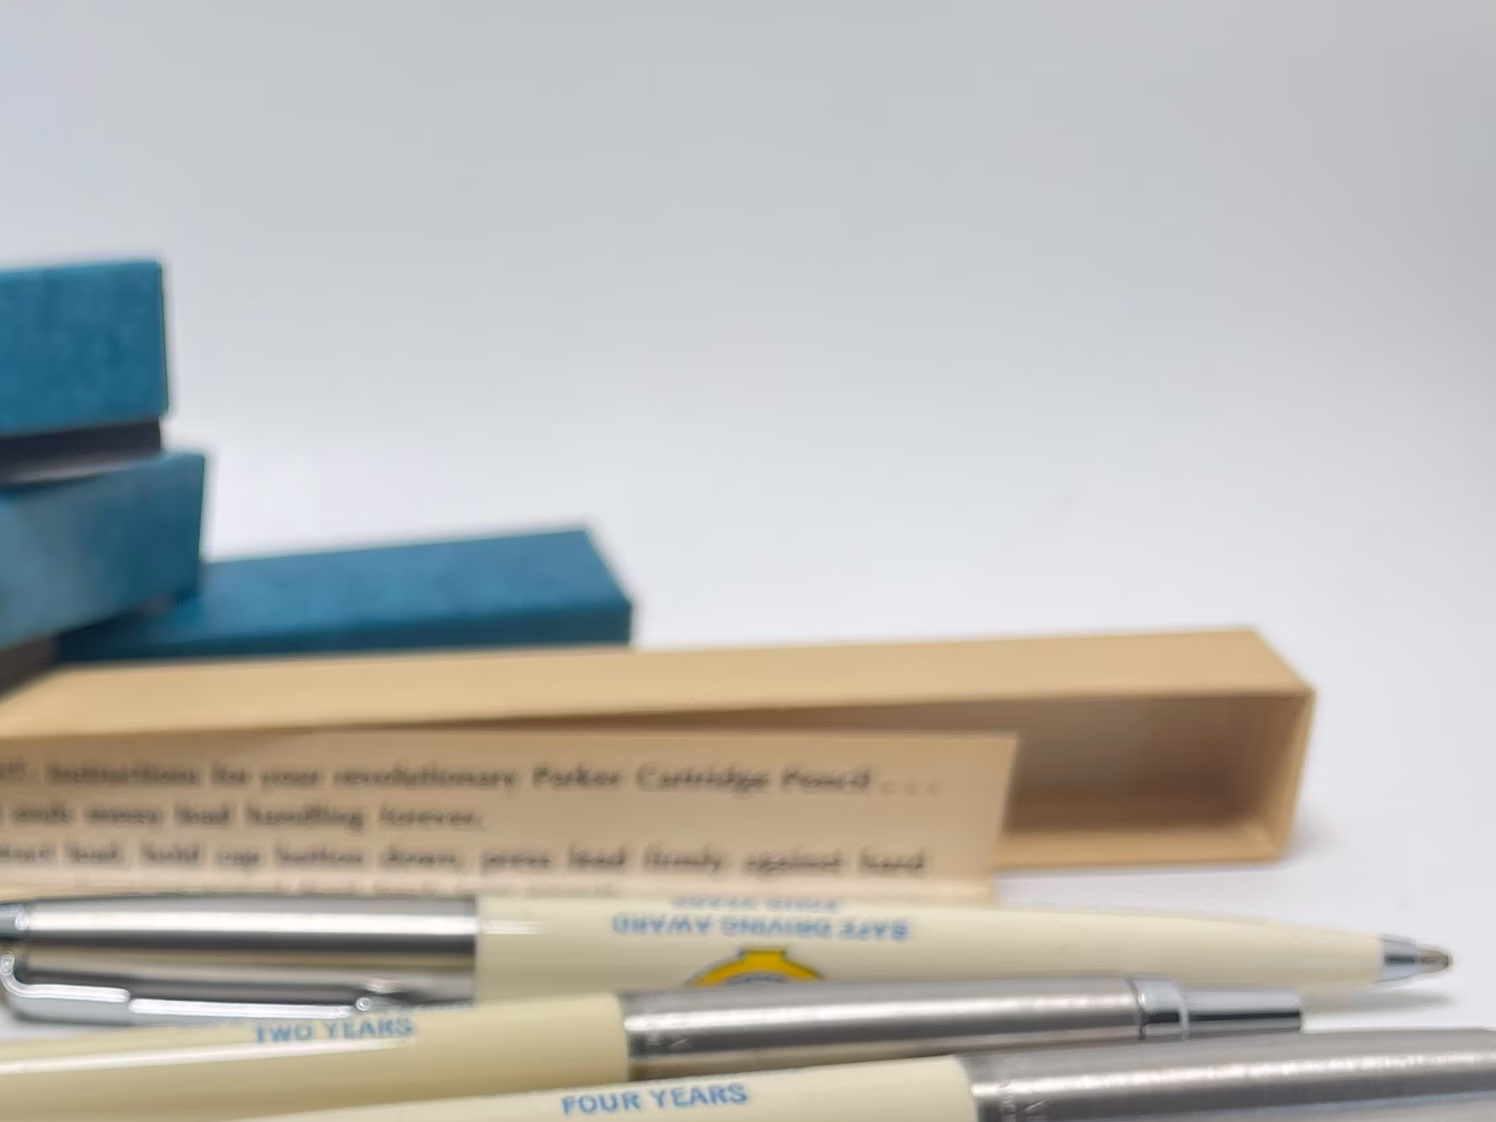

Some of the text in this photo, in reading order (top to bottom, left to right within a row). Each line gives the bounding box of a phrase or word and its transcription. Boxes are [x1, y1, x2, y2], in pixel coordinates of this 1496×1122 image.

[531, 763, 621, 790] Parker
[636, 763, 770, 797] Cartridge
[610, 910, 710, 936] AWARD
[720, 912, 832, 940] DRIVING
[256, 1015, 415, 1043] TWO YEARS
[561, 1082, 750, 1117] FOUR YEARS
